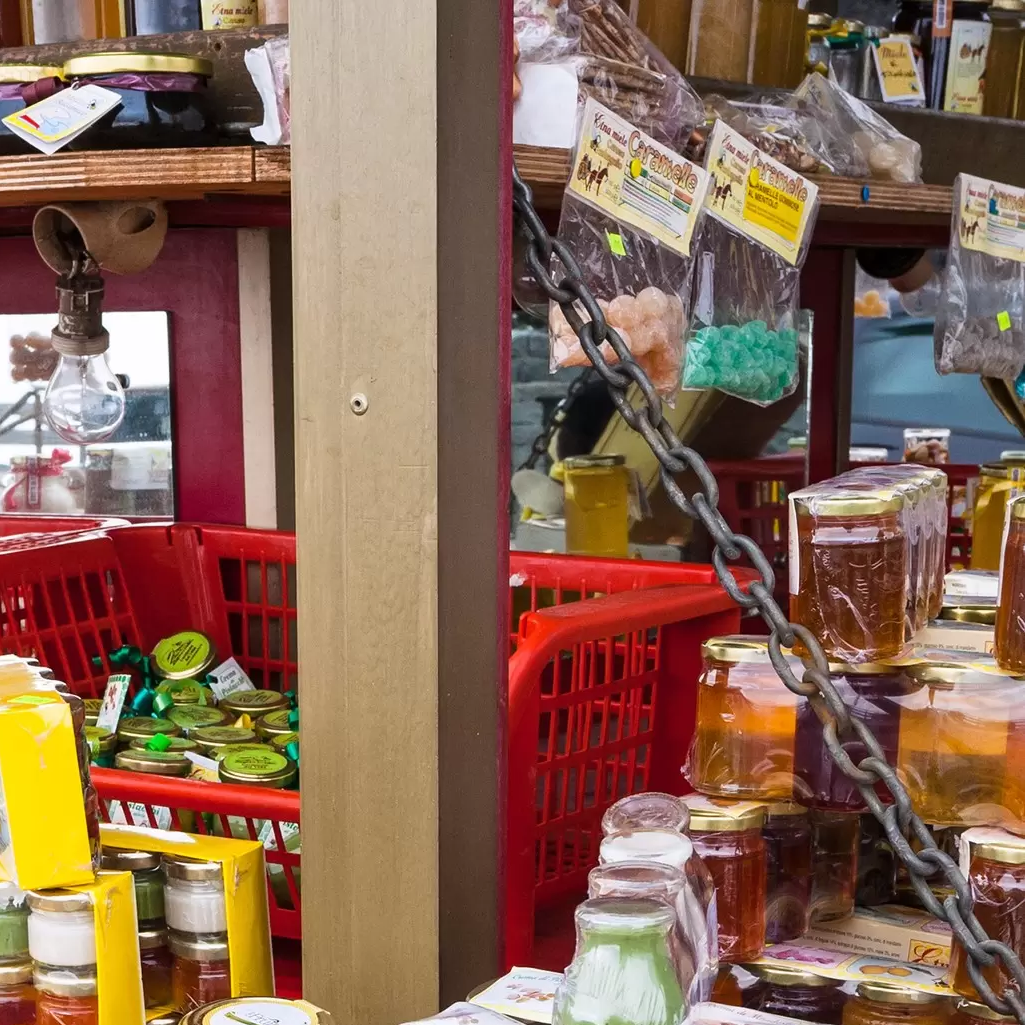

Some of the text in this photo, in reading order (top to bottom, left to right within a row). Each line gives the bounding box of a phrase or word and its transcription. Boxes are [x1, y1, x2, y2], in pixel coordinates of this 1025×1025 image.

[212, 3, 232, 15] Etna
[628, 130, 699, 195] Caramelle
[750, 149, 809, 202] Caramelle
